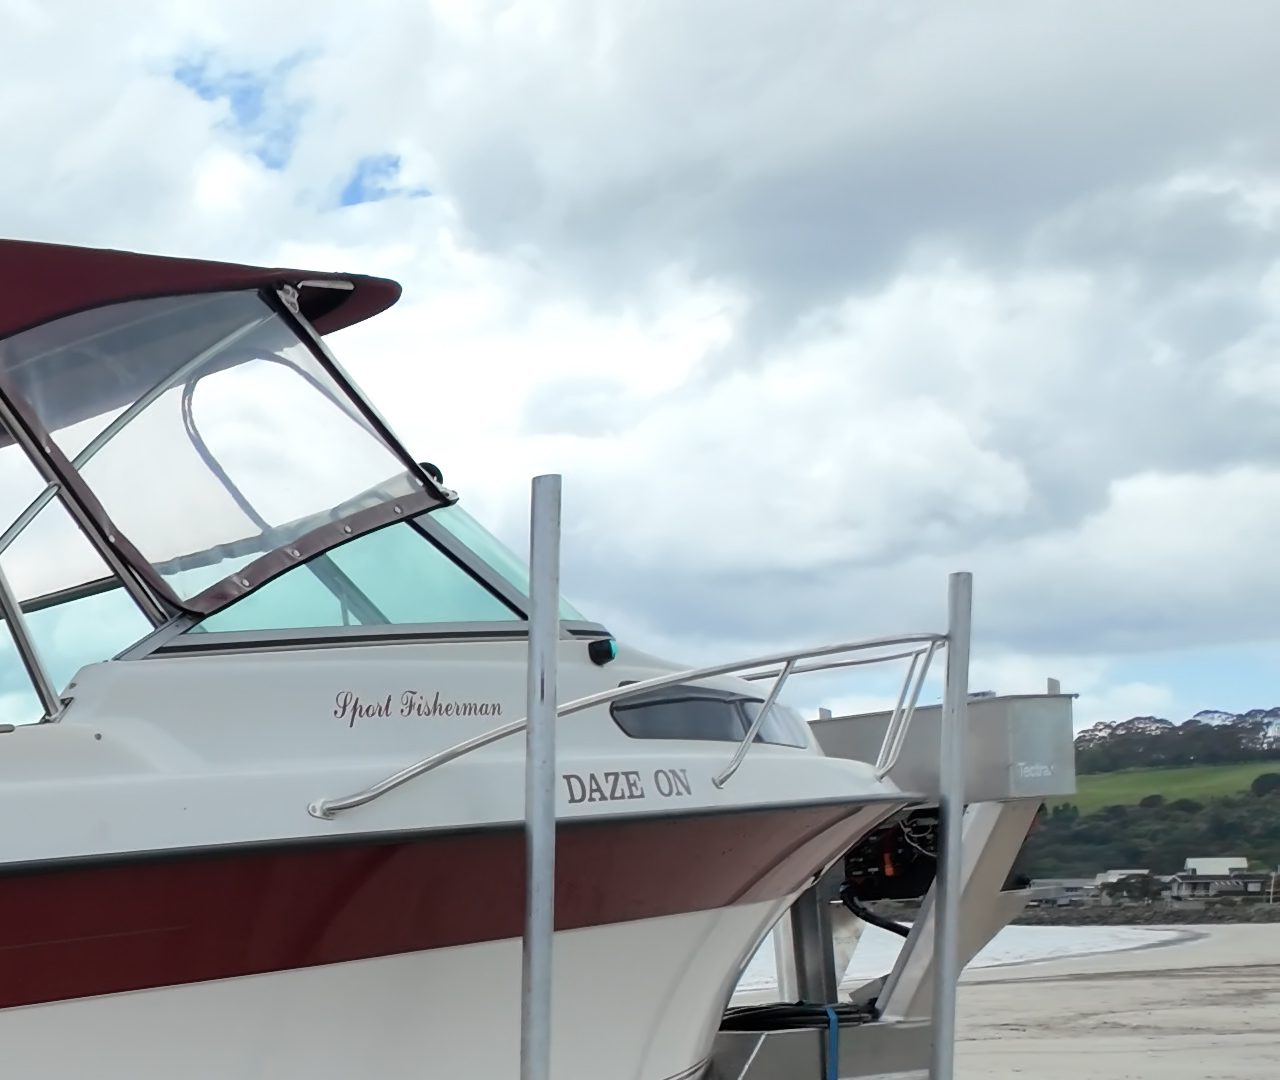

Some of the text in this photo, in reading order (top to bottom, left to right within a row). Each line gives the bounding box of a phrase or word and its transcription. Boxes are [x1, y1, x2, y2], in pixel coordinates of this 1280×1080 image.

[333, 690, 503, 728] Sport Fisherman
[562, 769, 692, 804] DAZE ON
